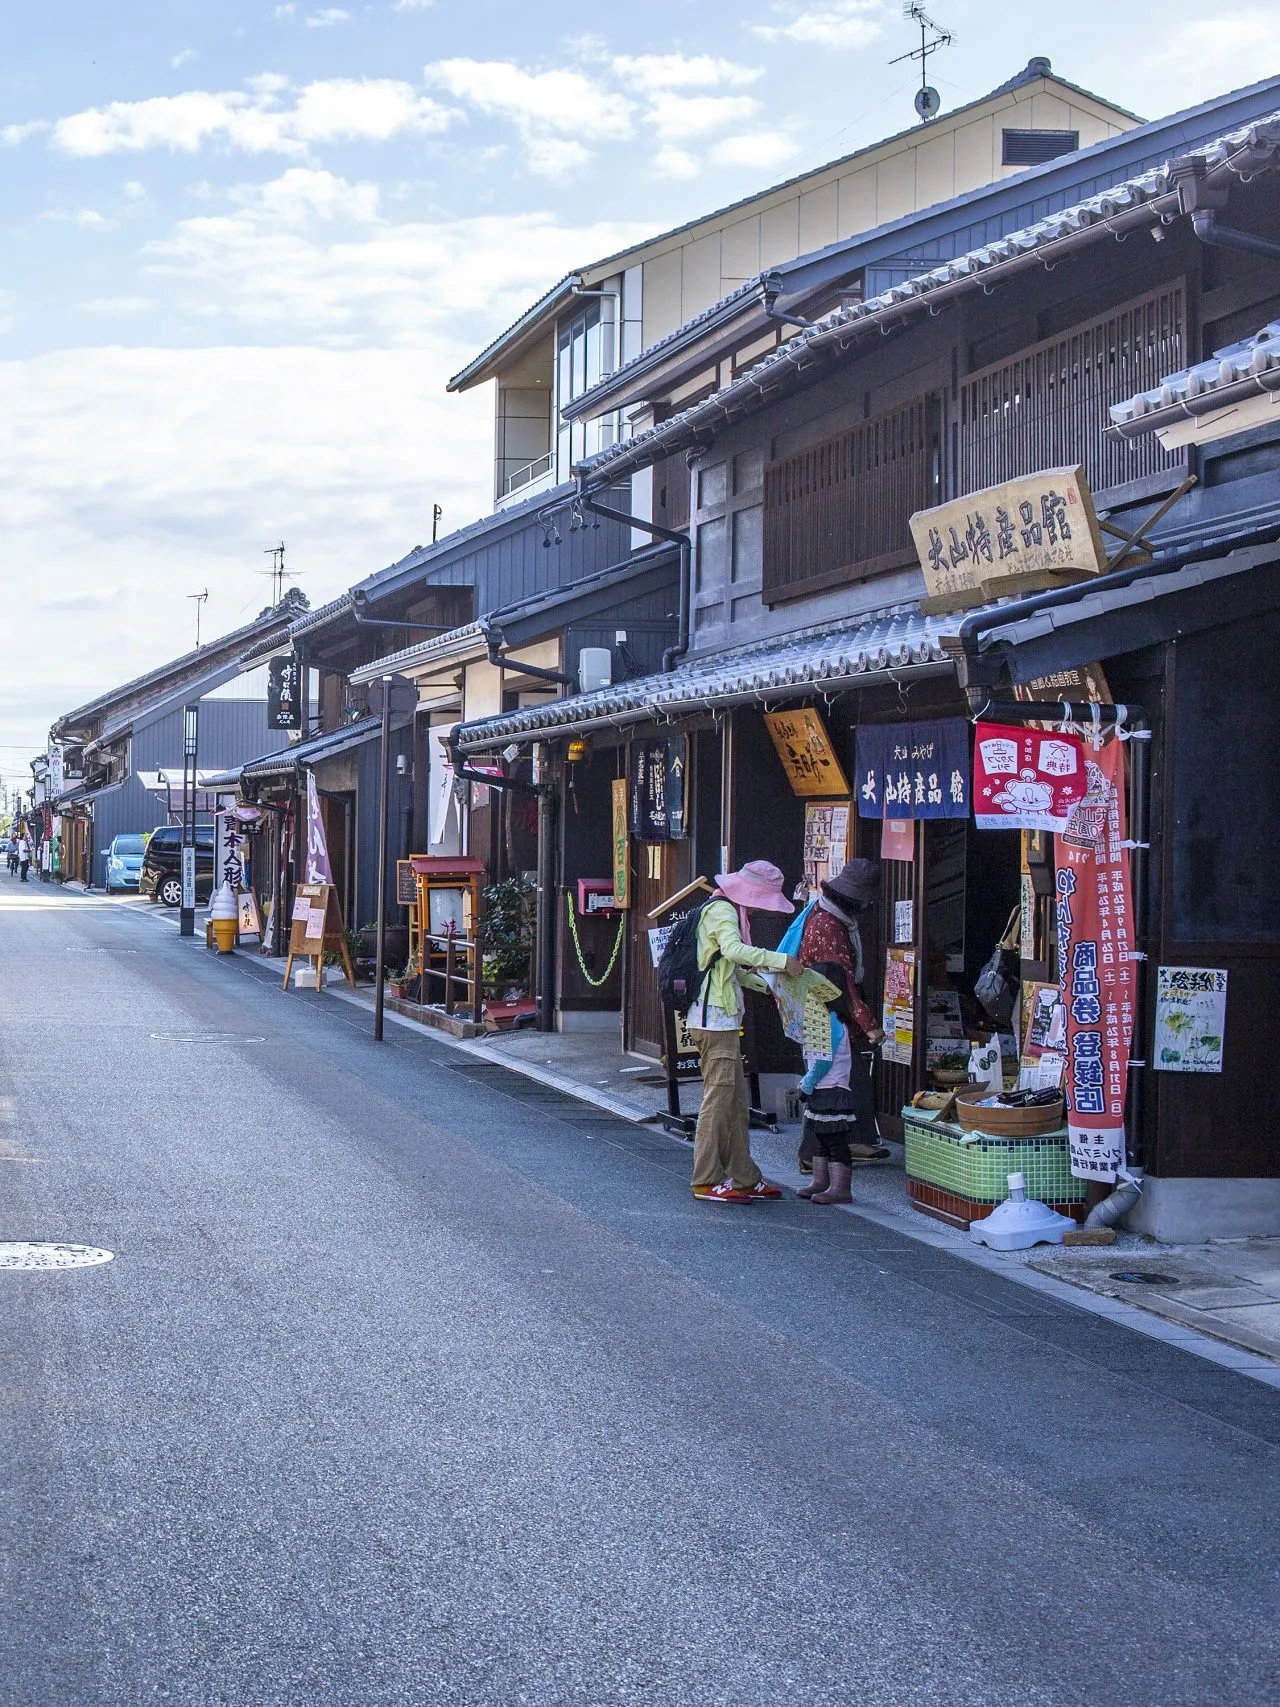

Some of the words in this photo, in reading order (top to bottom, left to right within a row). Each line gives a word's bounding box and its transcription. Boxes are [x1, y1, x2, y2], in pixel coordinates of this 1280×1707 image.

[928, 490, 1072, 571] 犬山特産品館
[862, 769, 964, 806] 犬山特産品館
[676, 1058, 701, 1071] お気
[712, 1185, 728, 1195] N
